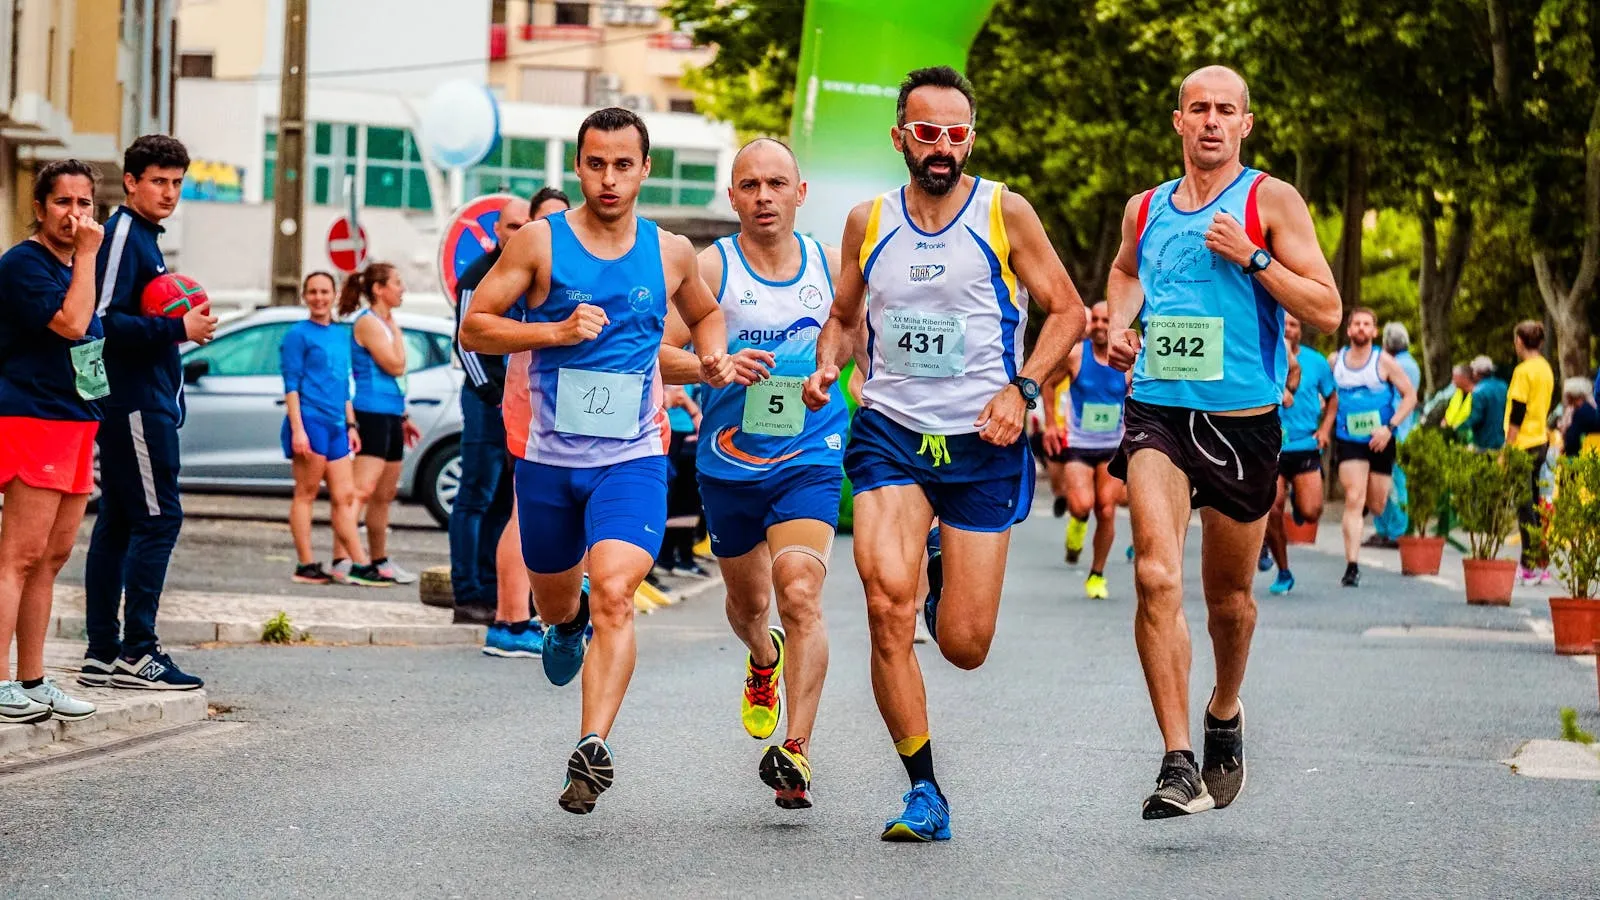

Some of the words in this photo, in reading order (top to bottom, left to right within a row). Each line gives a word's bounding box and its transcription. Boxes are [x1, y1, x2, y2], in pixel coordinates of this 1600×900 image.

[922, 318, 955, 327] Riberinha
[897, 331, 944, 355] 431
[1156, 336, 1205, 357] 342
[582, 386, 615, 415] 12
[767, 394, 784, 415] 5
